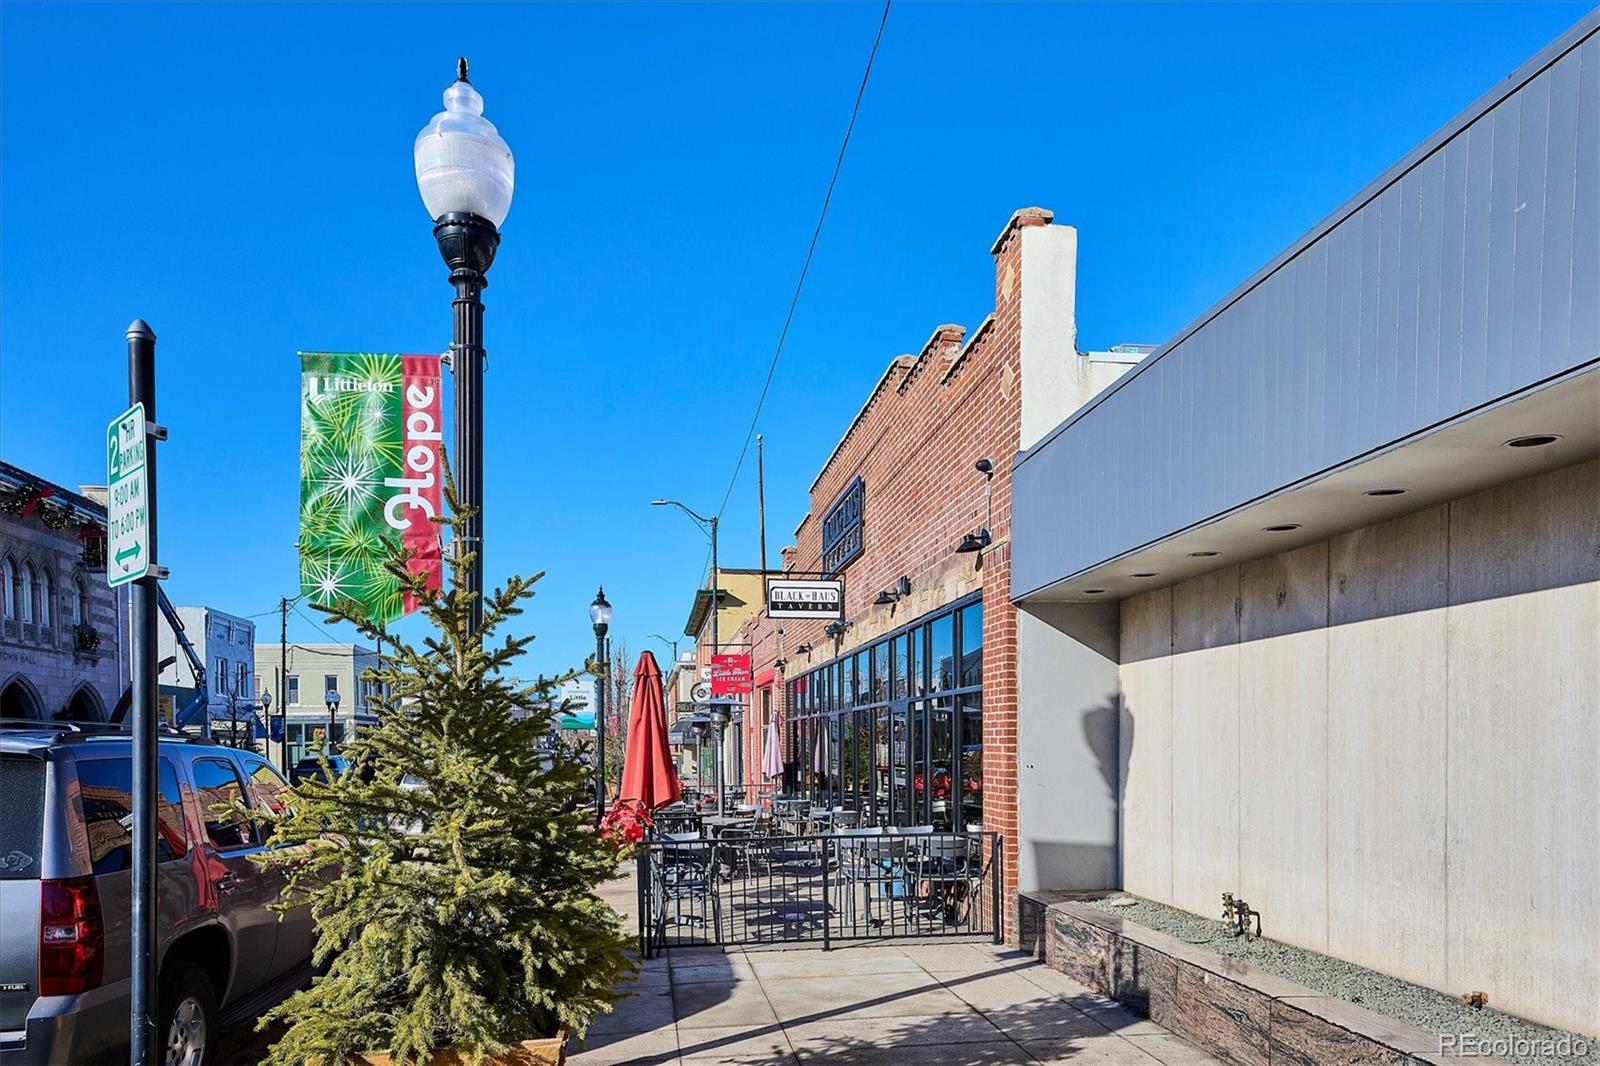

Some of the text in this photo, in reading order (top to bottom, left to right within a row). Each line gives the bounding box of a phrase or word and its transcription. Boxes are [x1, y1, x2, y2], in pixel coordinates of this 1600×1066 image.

[323, 377, 393, 392] Littleton
[125, 419, 135, 443] HR
[110, 436, 118, 475] 2
[119, 441, 143, 473] PARKING
[384, 384, 442, 529] Hope
[130, 477, 140, 499] AM
[111, 518, 119, 540] TO
[136, 505, 145, 529] PM
[775, 591, 804, 600] BLACK
[812, 591, 836, 600] HAUS
